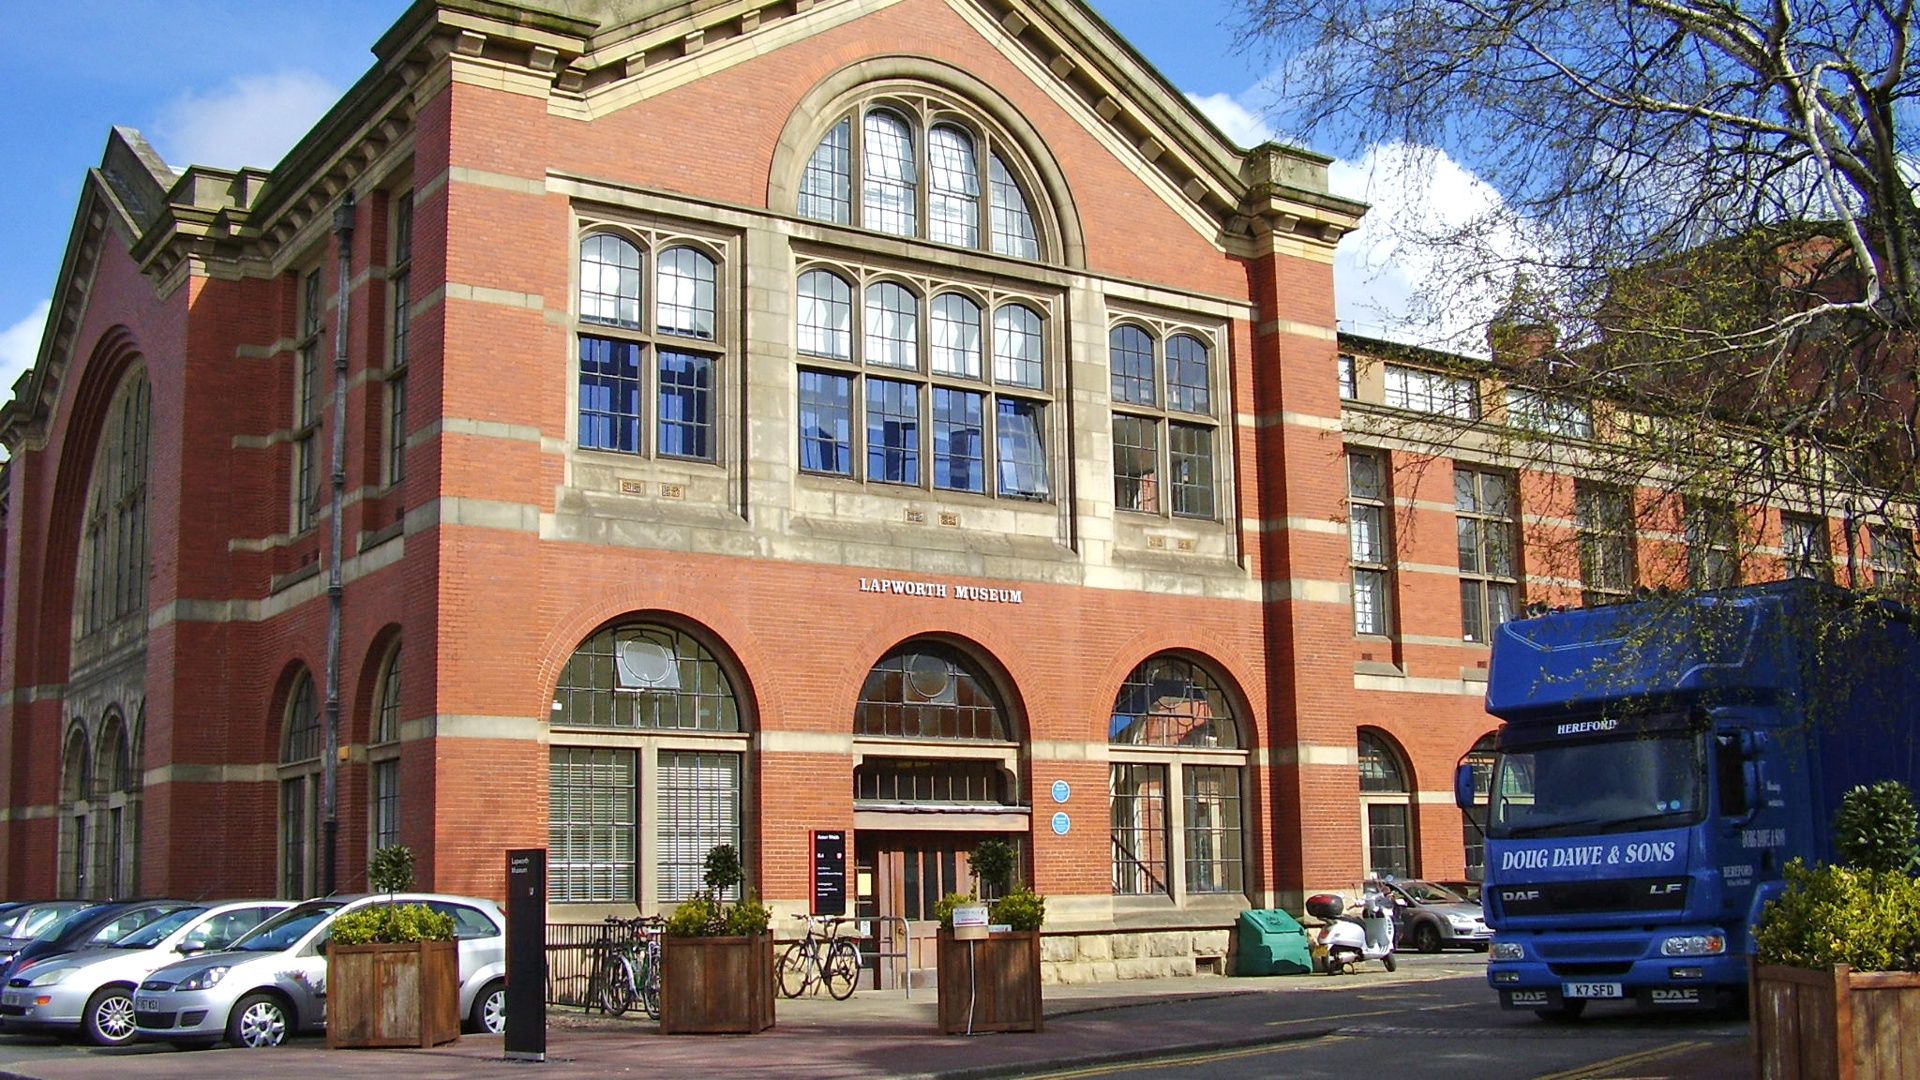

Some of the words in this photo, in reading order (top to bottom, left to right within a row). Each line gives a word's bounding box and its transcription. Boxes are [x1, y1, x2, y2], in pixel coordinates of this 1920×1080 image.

[860, 577, 947, 598] LAPWORTH
[954, 585, 1023, 603] MUSEUM
[1557, 719, 1617, 735] HEREFORD
[1502, 849, 1548, 870] DOUG
[1552, 846, 1602, 867] DAWE
[1607, 845, 1620, 864] &
[1625, 841, 1676, 863] SONS
[1723, 865, 1753, 877] HEREFORD
[1649, 883, 1682, 894] LF
[1502, 890, 1540, 901] DAF
[1512, 991, 1548, 1000] DAF
[1575, 984, 1589, 996] K7
[1592, 984, 1614, 996] SFD
[1652, 989, 1698, 999] DAF
